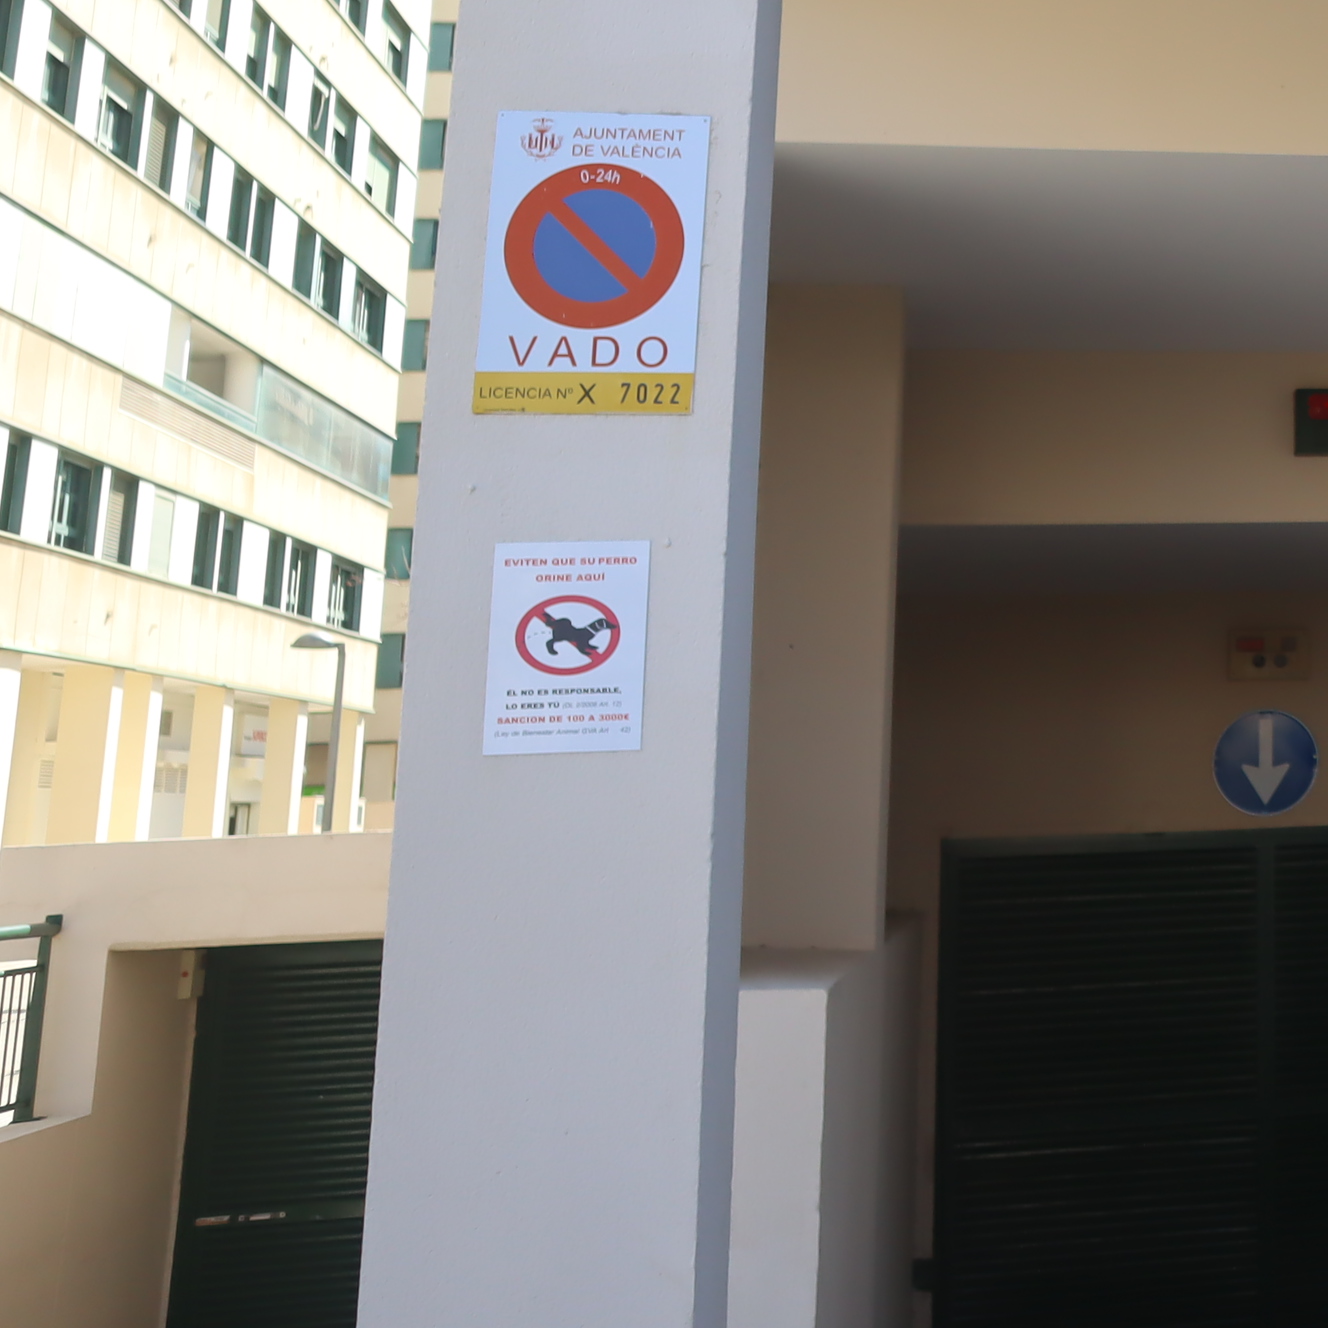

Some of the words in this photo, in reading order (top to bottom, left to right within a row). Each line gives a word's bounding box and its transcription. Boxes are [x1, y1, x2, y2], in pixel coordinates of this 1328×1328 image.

[572, 126, 686, 142] AJUNTAMENT
[571, 144, 594, 157] DE
[600, 143, 682, 159] VALÈNCIA
[580, 168, 621, 185] 0-24h
[508, 335, 669, 368] VADO
[479, 387, 552, 400] LICENCIA
[576, 383, 597, 405] X
[619, 382, 681, 405] 7022
[504, 558, 548, 567] EVITEN
[551, 558, 576, 566] QUE
[579, 557, 596, 565] SU
[598, 556, 638, 565] PERRO
[535, 574, 572, 583] ORINE
[537, 688, 549, 696] ES
[549, 715, 563, 723] DE
[567, 714, 585, 722] 100
[587, 714, 595, 722] A
[598, 713, 630, 721] 3000€
